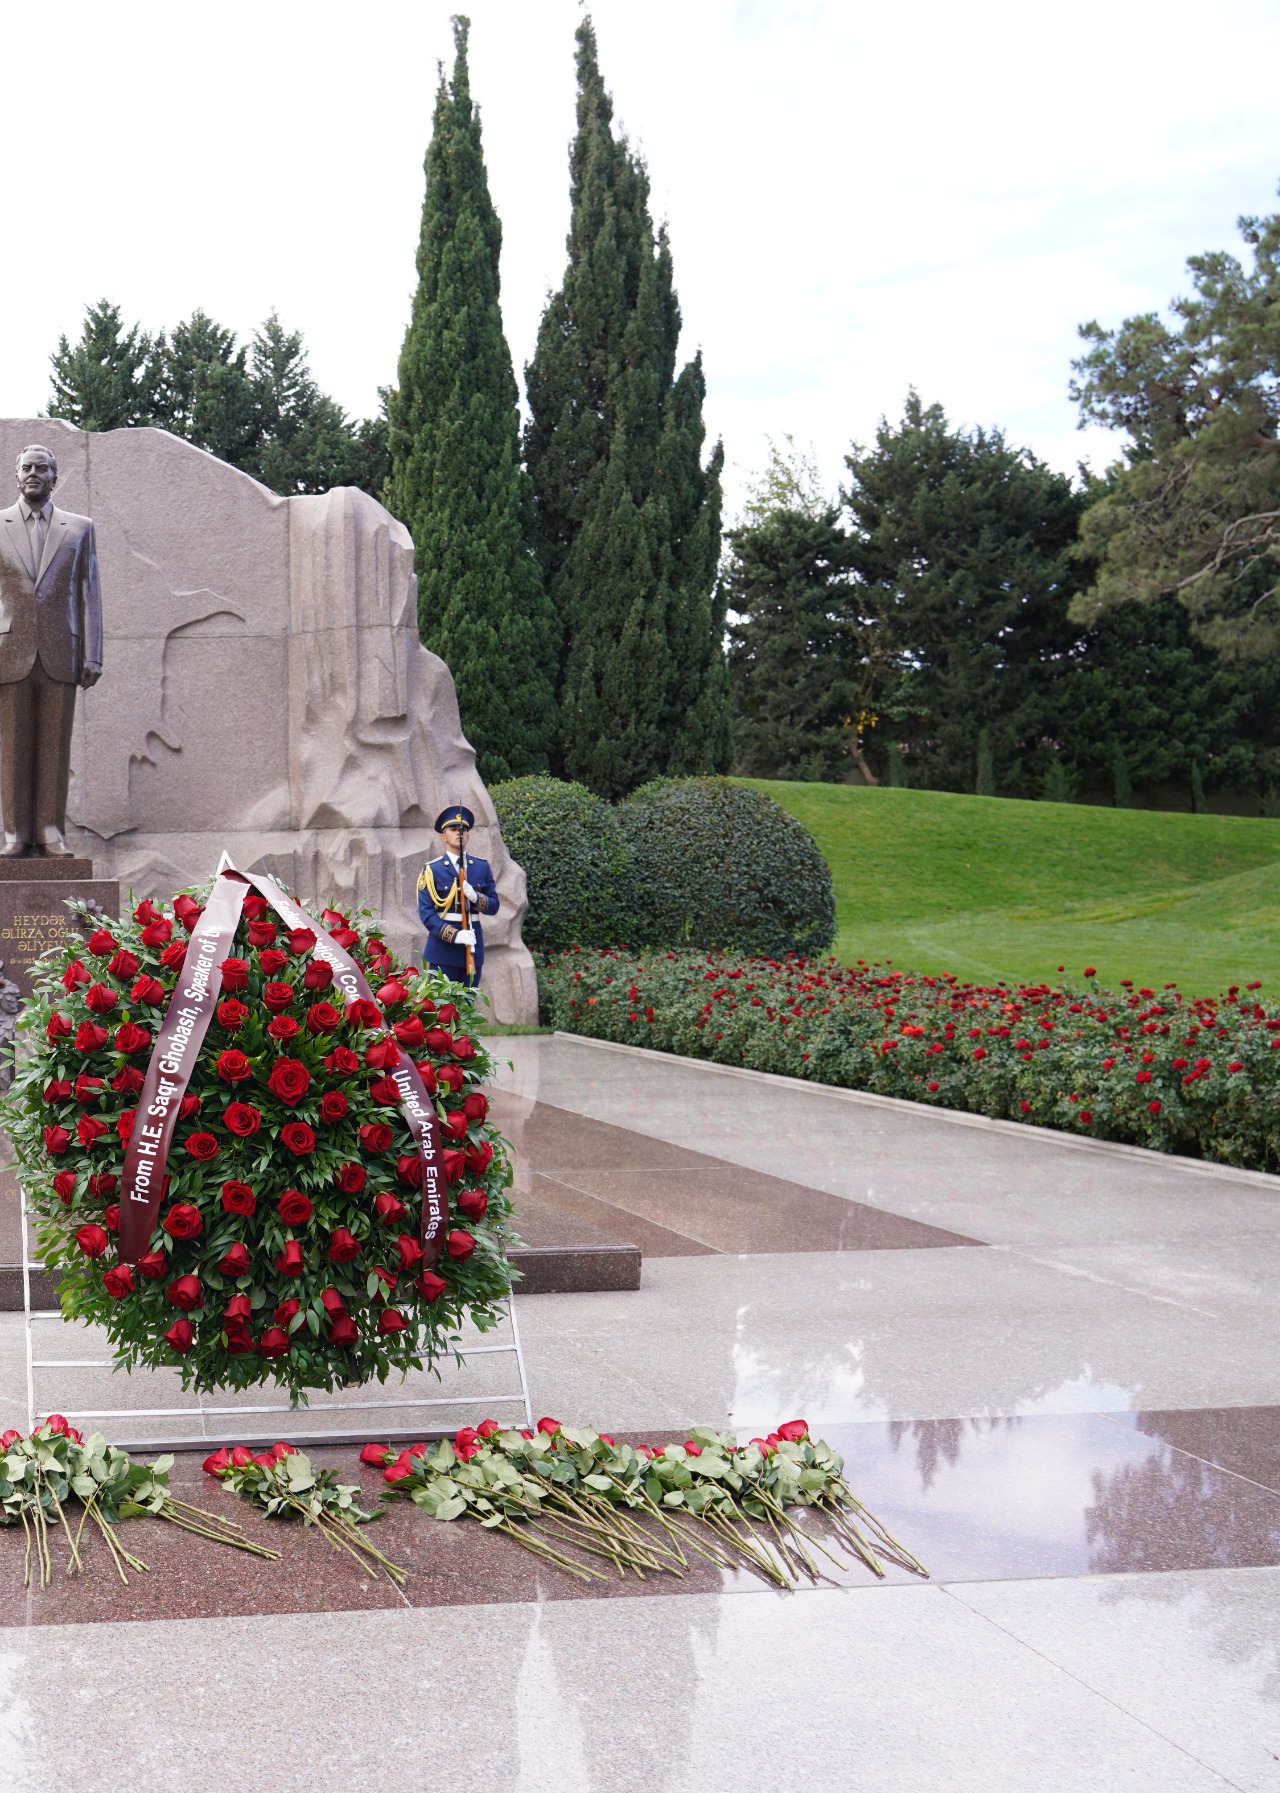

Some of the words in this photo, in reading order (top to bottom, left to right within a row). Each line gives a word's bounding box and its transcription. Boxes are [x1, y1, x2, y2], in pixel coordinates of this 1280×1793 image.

[1, 926, 45, 939] ƏLİRZA
[13, 915, 67, 926] HEYDƏR
[200, 925, 224, 938] the
[198, 937, 218, 953] of
[183, 954, 214, 1002] Speaker
[158, 1006, 203, 1074] Ghobash,
[147, 1076, 178, 1118] Saqr
[391, 1069, 430, 1118] United
[137, 1122, 164, 1156] H.E.
[417, 1120, 436, 1160] Arab
[130, 1159, 155, 1204] From
[424, 1166, 443, 1240] Emirates
